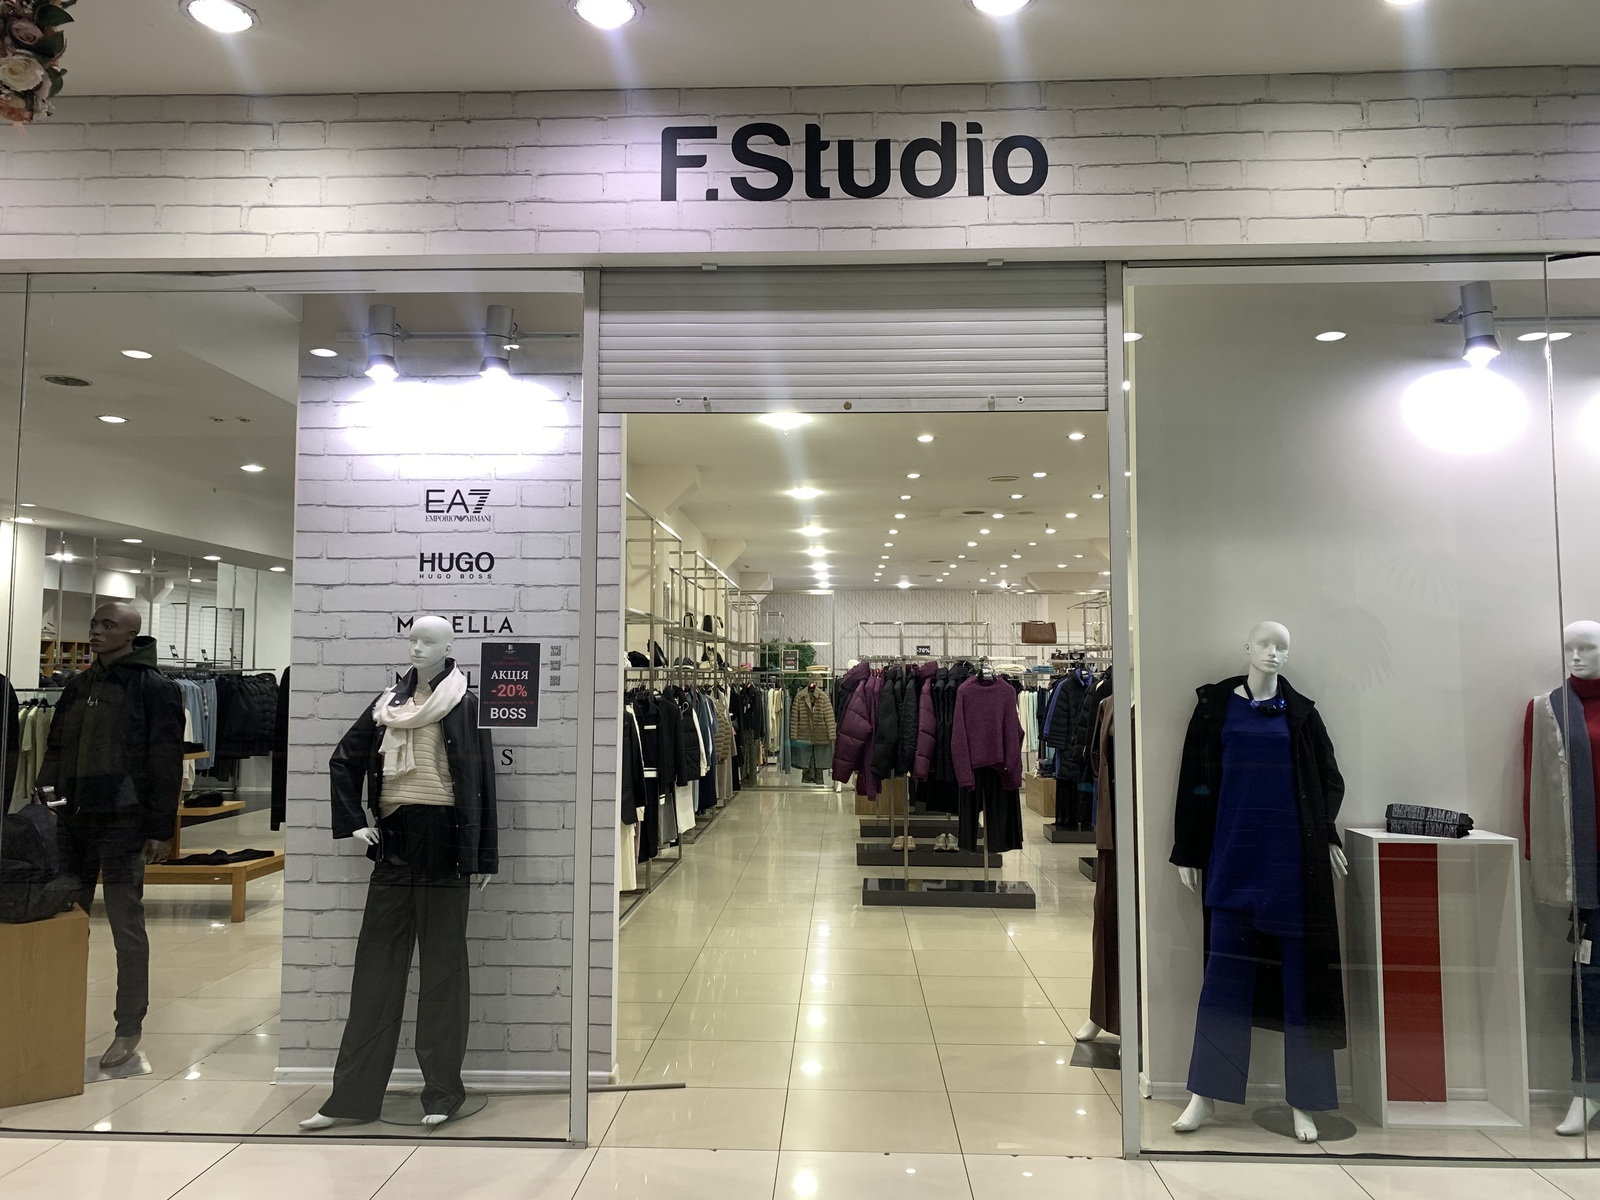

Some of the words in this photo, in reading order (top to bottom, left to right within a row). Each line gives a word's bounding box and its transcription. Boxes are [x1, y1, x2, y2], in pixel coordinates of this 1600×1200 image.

[661, 121, 1049, 201] F.Studio
[425, 489, 491, 514] EA7
[419, 552, 495, 573] HUGO
[397, 616, 513, 633] MELLA
[490, 670, 529, 681] АКЦІЯ
[491, 684, 528, 697] -20%
[490, 707, 527, 719] BOSS
